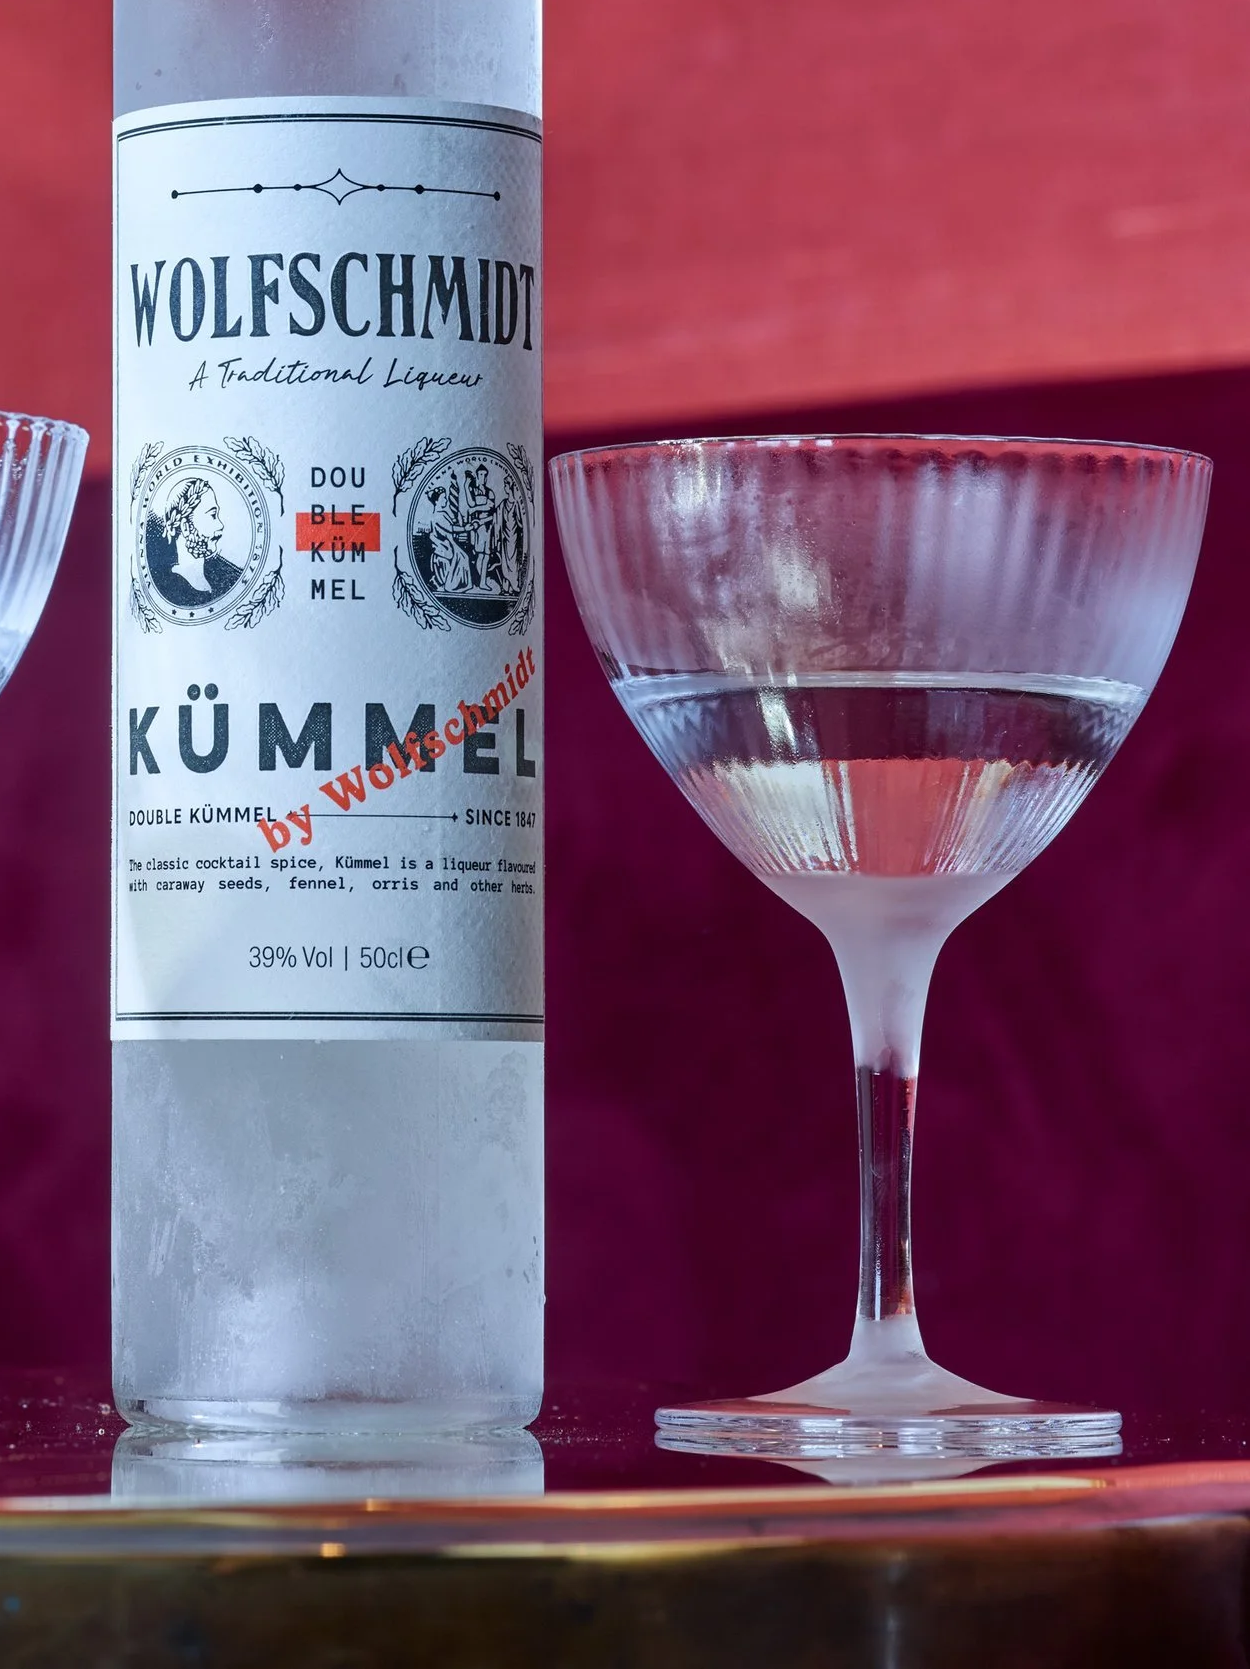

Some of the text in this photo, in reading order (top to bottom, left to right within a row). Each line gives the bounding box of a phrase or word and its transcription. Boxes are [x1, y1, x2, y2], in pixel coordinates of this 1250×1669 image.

[130, 252, 535, 351] WOLFSCHMIDT
[189, 357, 483, 391] A Traditional Liqueur
[312, 467, 364, 488] DOU
[312, 505, 365, 525] BLE
[312, 536, 365, 562] KÜM
[312, 579, 365, 600] MEL
[129, 683, 536, 778] KÜMMEL
[258, 652, 534, 851] by Wolfschmidt
[130, 804, 276, 826] DOUBLE KÜMMEL
[466, 809, 535, 827] SINCE 1847
[130, 856, 535, 873] The classic cocktail spice, Kümmel is a liqueur flavoured
[157, 881, 204, 893] caraway
[219, 877, 269, 892] seeds,
[290, 877, 353, 892] fennel,
[373, 880, 418, 890] orris
[434, 878, 458, 891] and
[471, 879, 503, 892] other
[512, 880, 535, 894] herbs.
[250, 946, 296, 967] 39%
[302, 947, 332, 968] Vol
